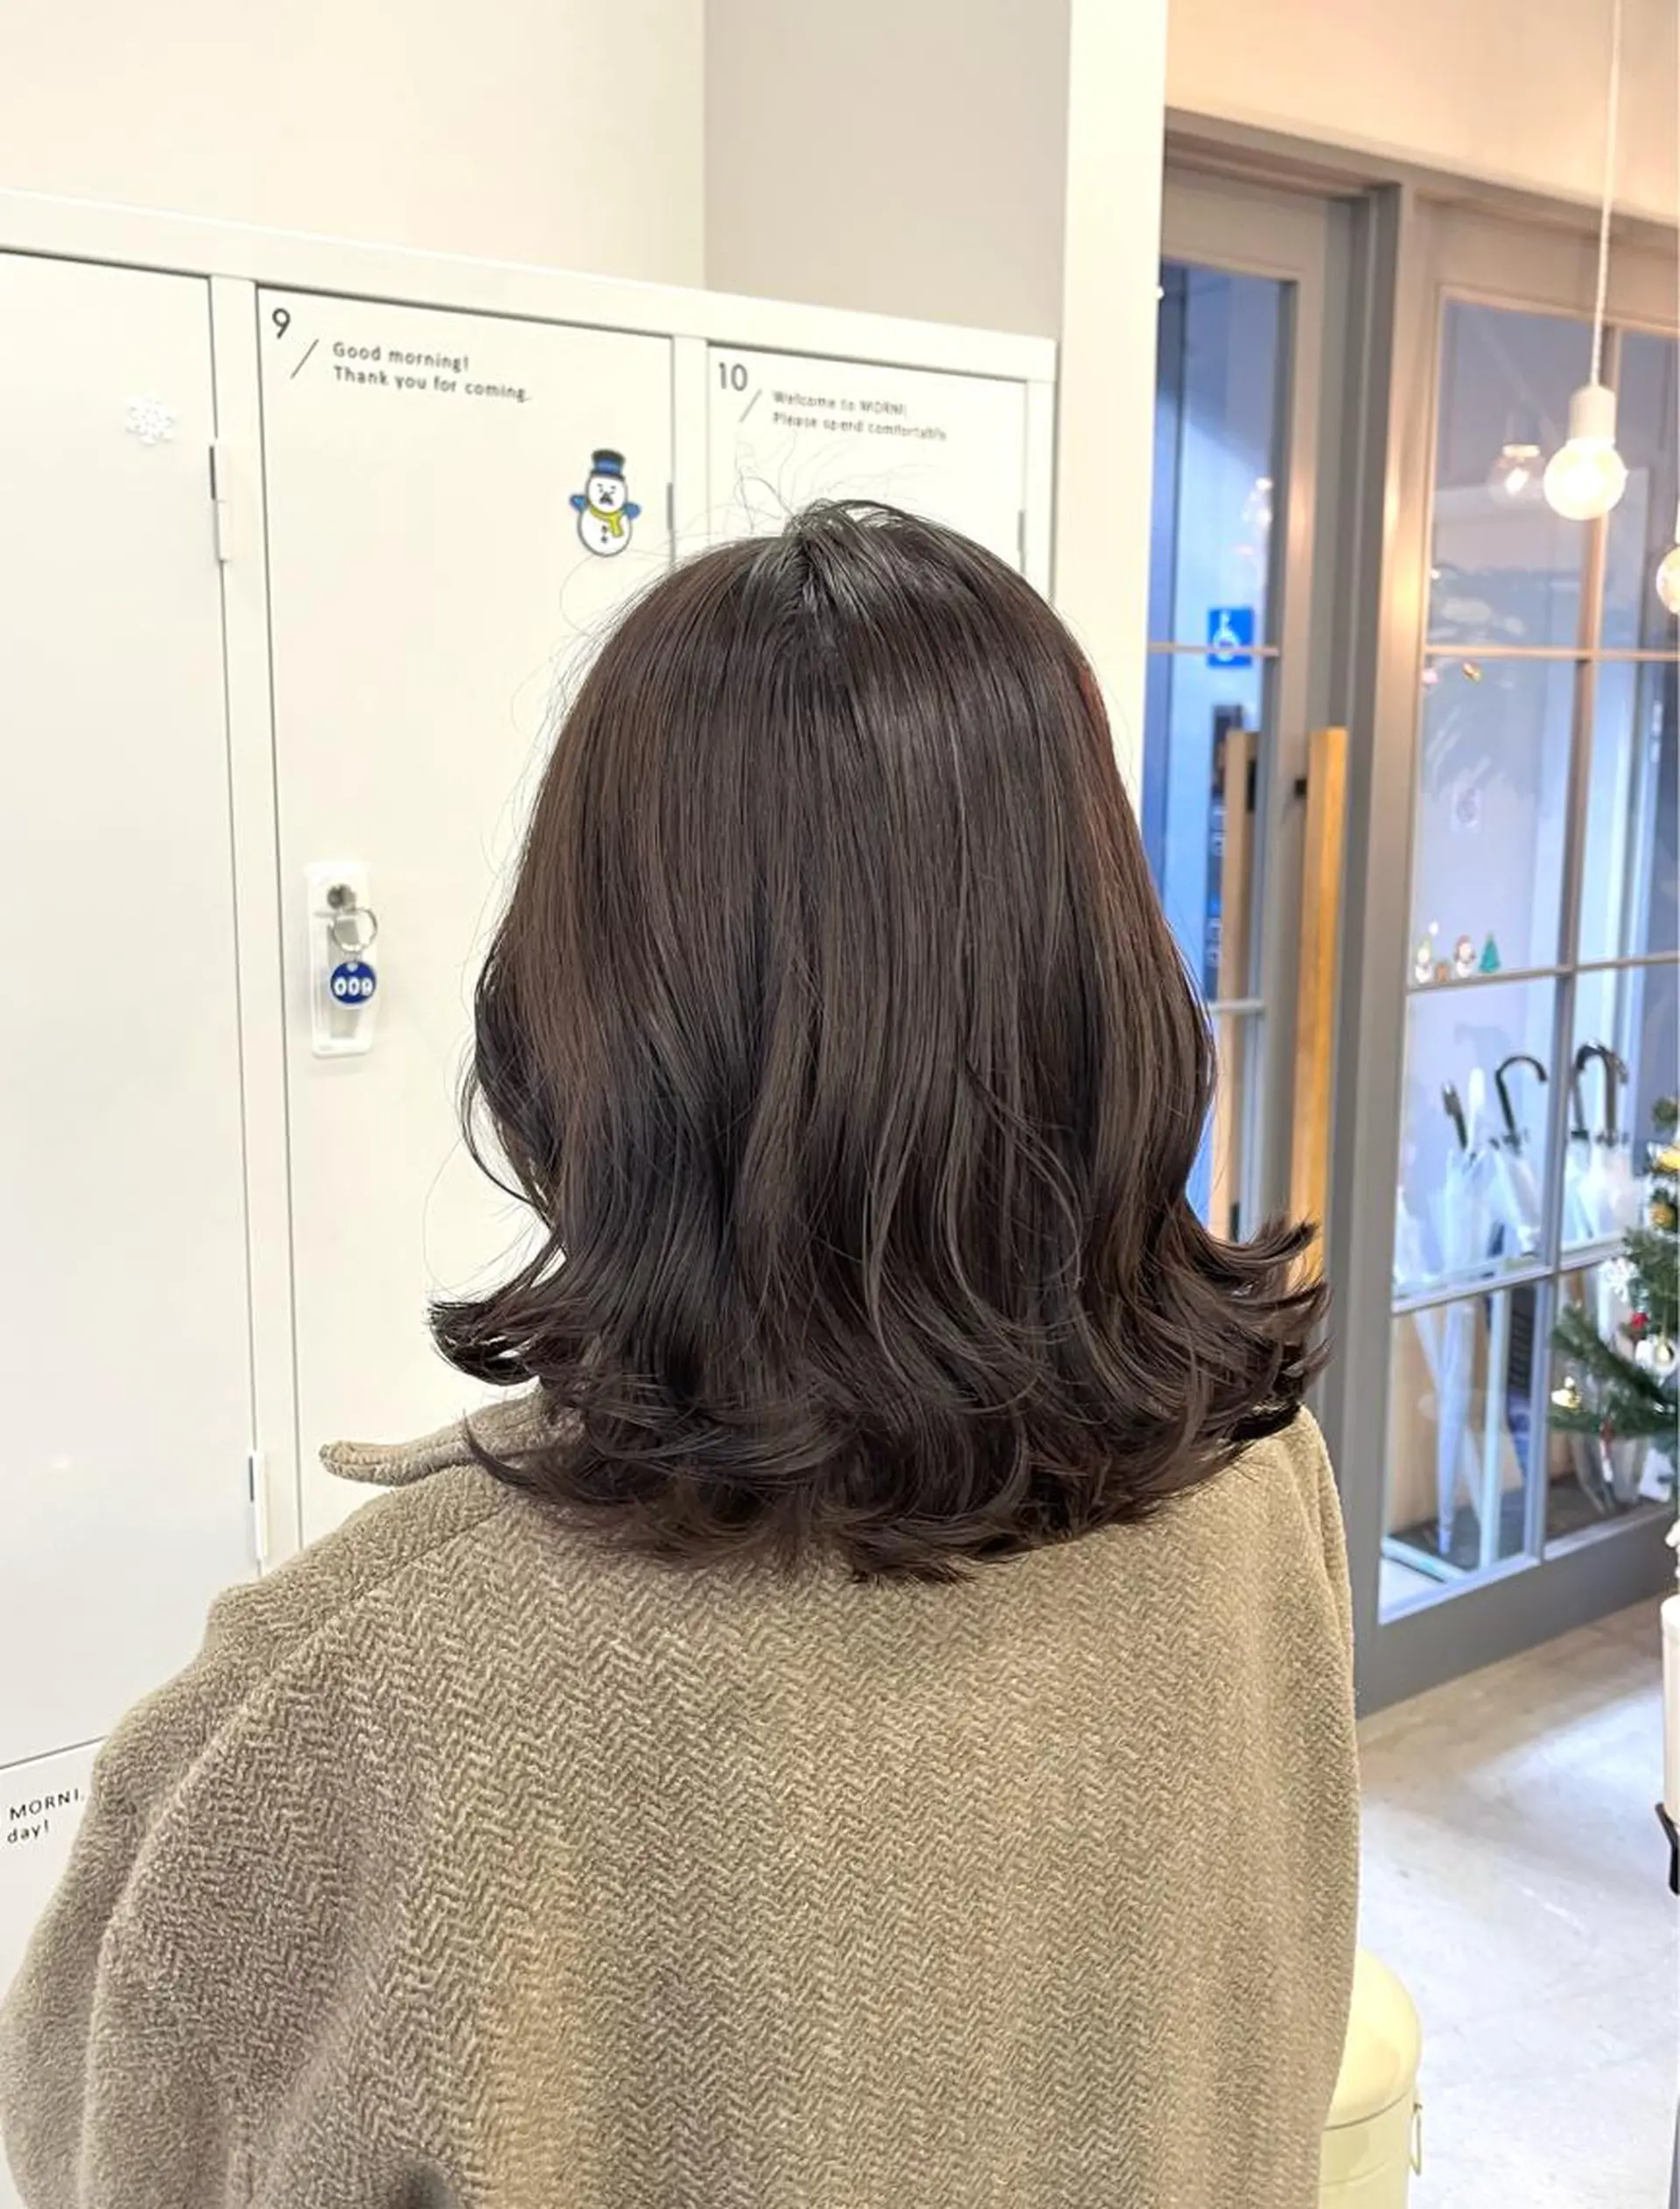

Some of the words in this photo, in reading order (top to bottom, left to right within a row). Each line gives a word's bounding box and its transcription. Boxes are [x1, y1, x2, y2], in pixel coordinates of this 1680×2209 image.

[272, 308, 290, 340] 9
[332, 341, 382, 361] Good
[388, 350, 469, 374] morning!
[333, 366, 388, 387] Thank
[394, 375, 427, 390] you
[434, 376, 457, 393] for
[718, 361, 748, 391] 10
